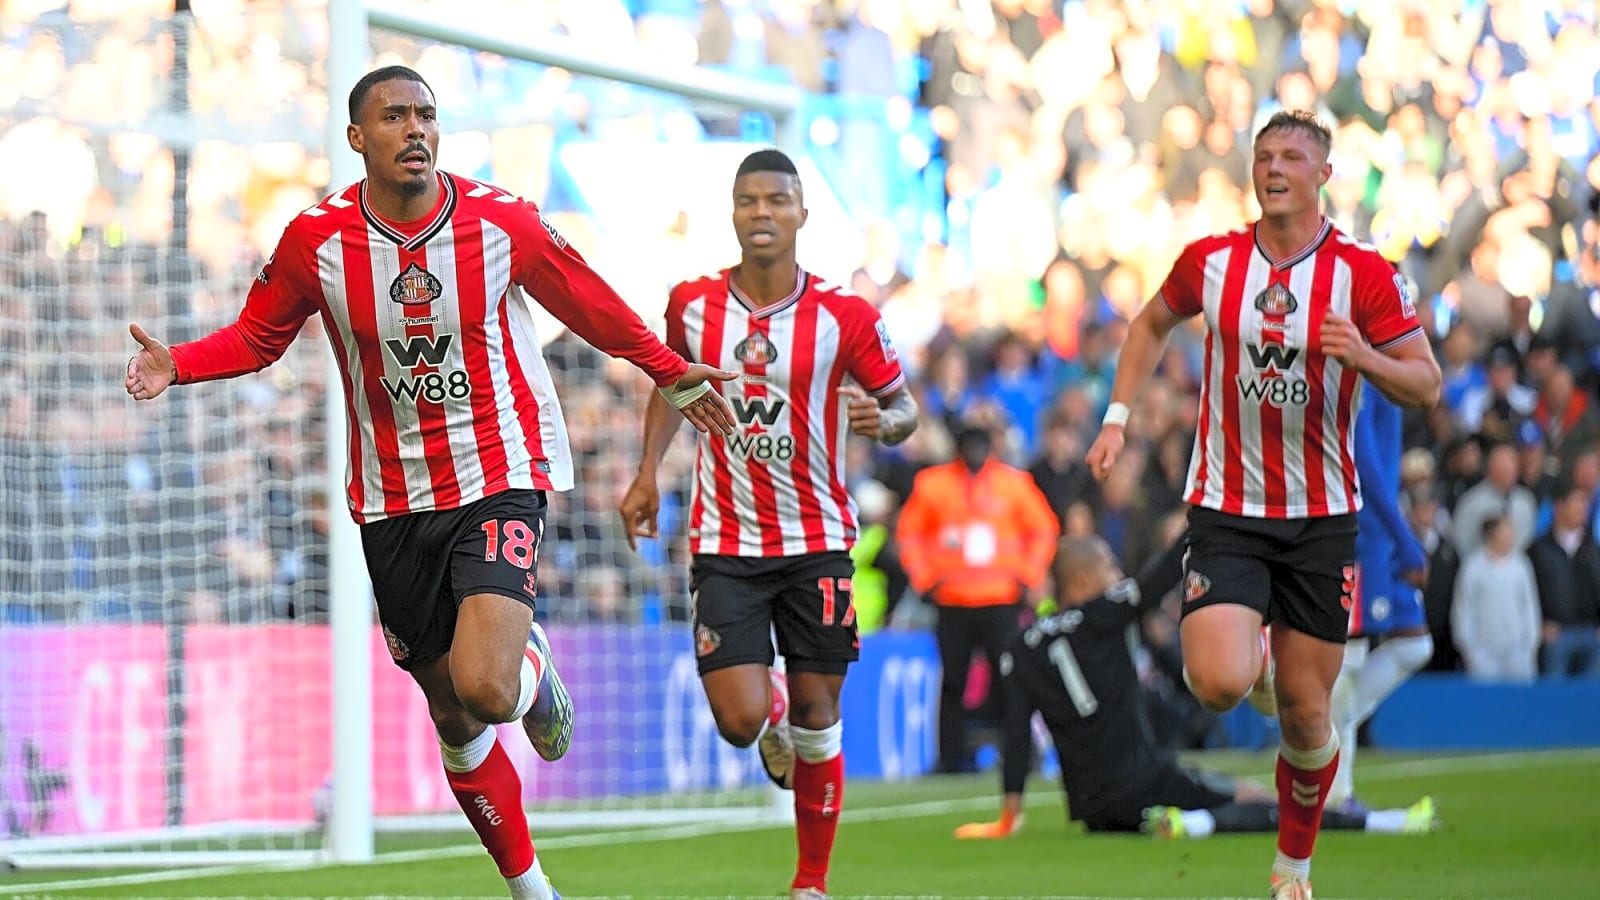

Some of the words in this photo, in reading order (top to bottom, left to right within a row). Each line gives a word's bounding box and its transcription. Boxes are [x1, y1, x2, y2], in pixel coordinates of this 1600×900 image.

[407, 314, 439, 325] hummel
[379, 369, 472, 403] W88
[1236, 376, 1309, 406] W88
[725, 434, 793, 461] W88
[481, 518, 536, 570] 18
[817, 577, 856, 628] 17
[1047, 636, 1099, 718] 1
[474, 795, 504, 826] SAFC
